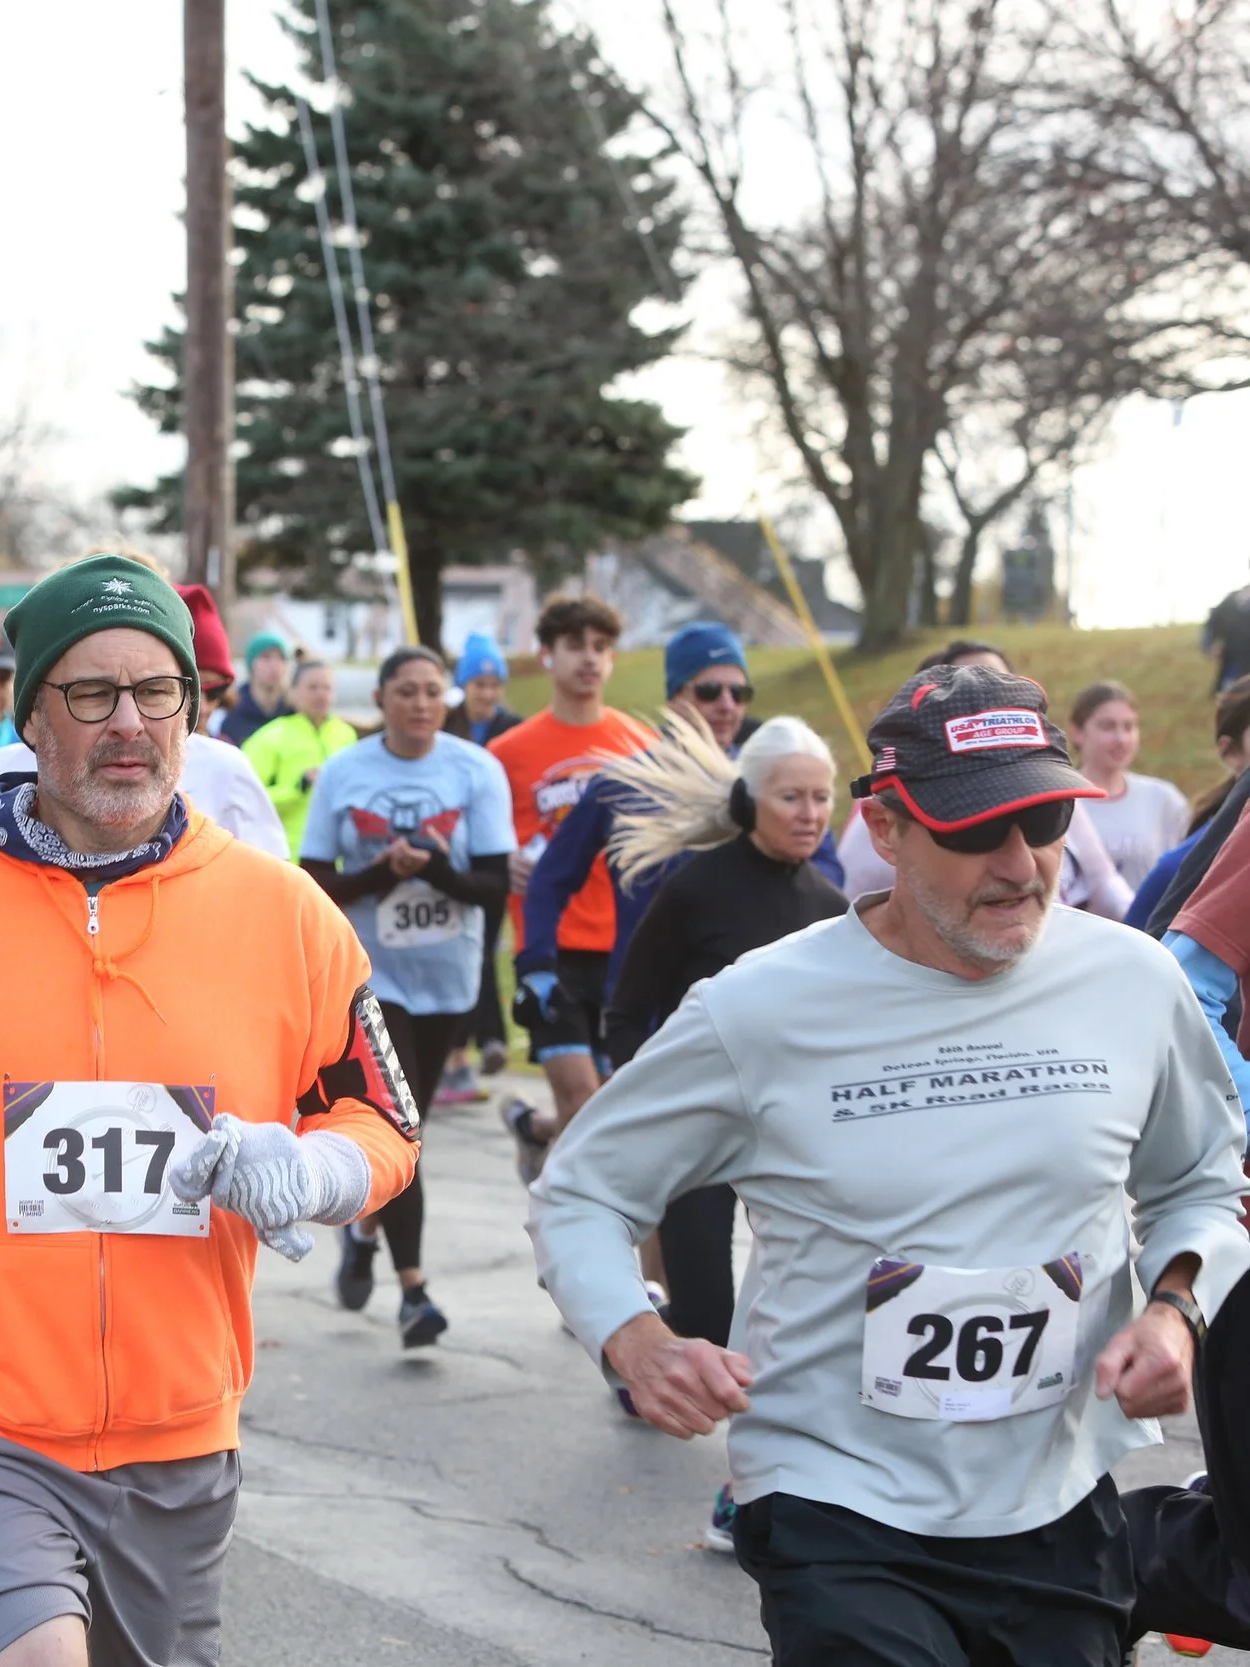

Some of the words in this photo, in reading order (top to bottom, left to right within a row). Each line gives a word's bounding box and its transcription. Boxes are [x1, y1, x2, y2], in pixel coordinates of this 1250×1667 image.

[93, 603, 151, 615] nysparks.com
[951, 722, 974, 733] USA
[982, 717, 1037, 727] TRIATHLON
[973, 728, 992, 738] AGE
[994, 727, 1026, 736] GROUP
[393, 901, 450, 931] 305
[832, 1080, 918, 1103] HALF
[928, 1063, 1109, 1090] MARATHON
[832, 1108, 855, 1118] &
[925, 1088, 1007, 1104] Road
[1019, 1080, 1111, 1094] Races
[42, 1127, 176, 1195] 317
[902, 1309, 1050, 1382] 267
